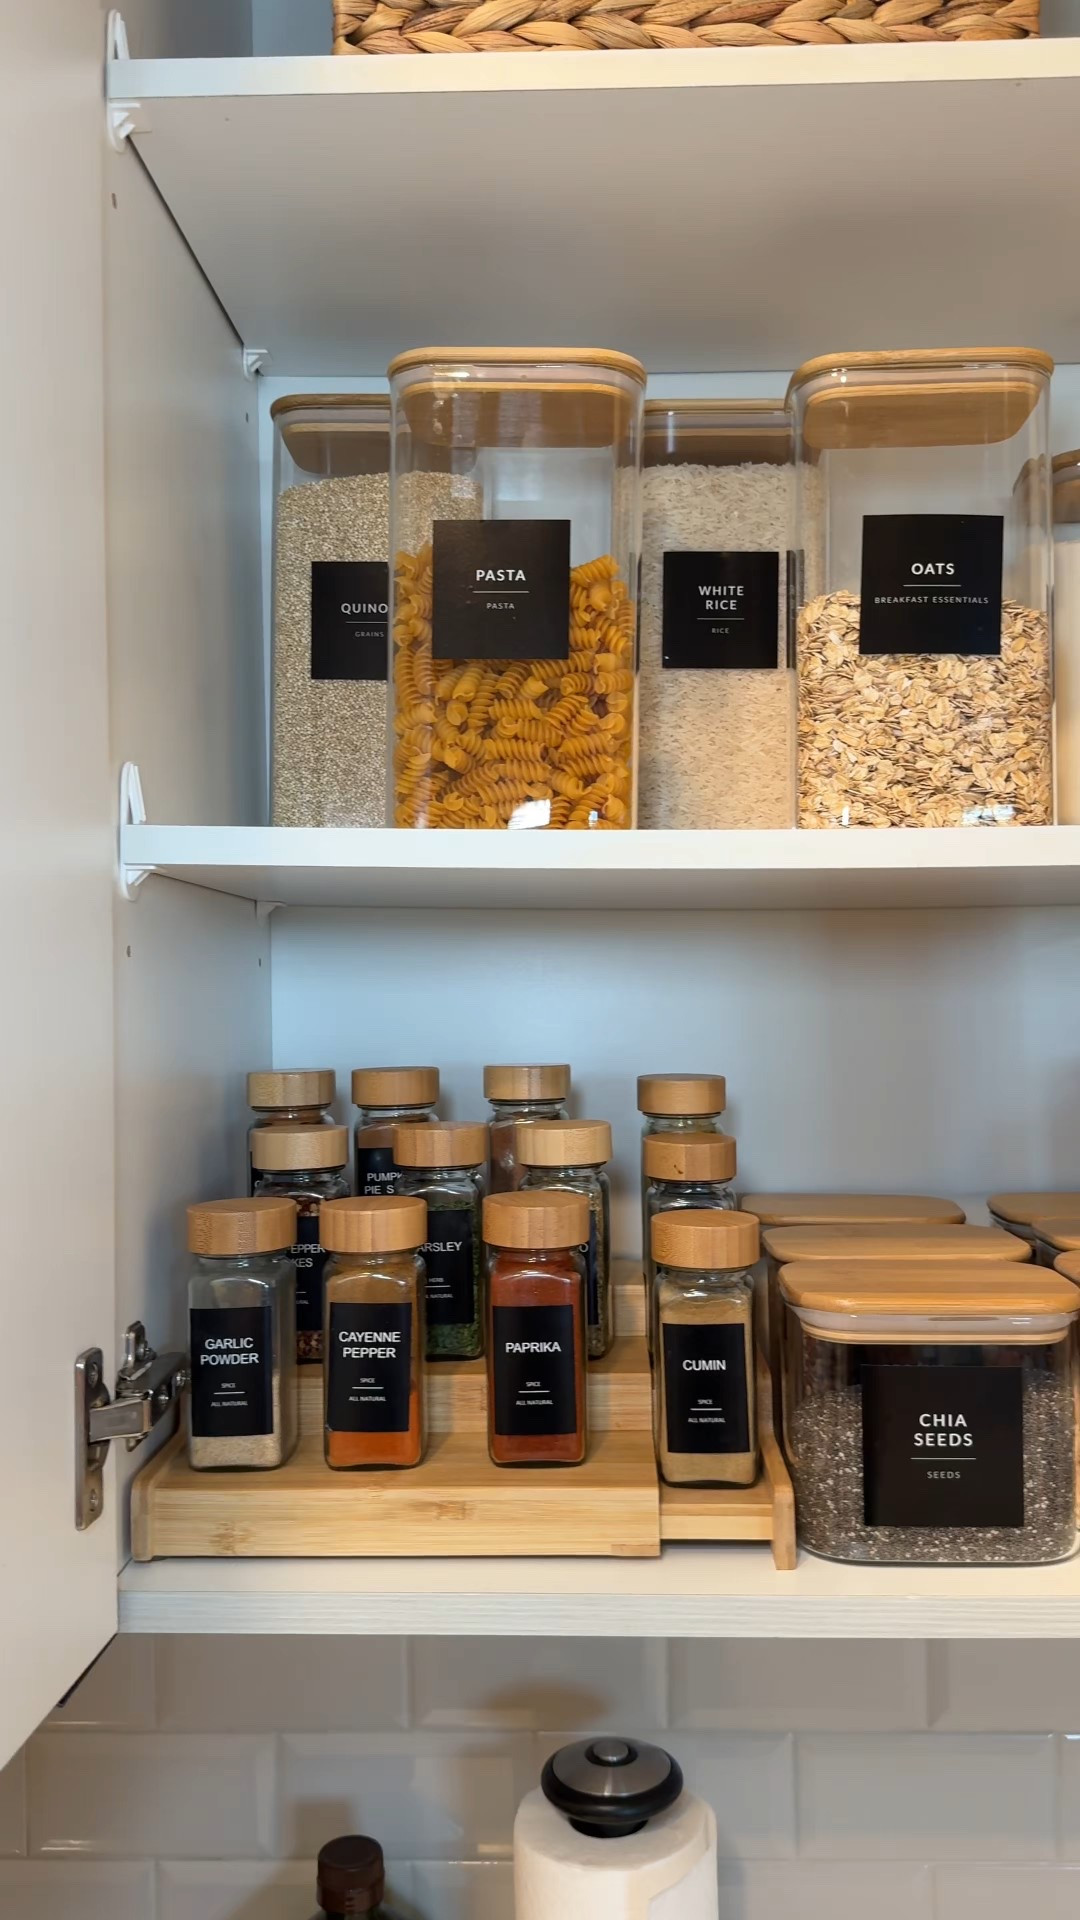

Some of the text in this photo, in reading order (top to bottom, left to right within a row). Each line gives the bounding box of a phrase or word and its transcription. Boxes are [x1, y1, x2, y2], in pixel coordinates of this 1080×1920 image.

[911, 562, 955, 575] OATS
[476, 569, 526, 582] PASTA
[698, 585, 744, 596] WHITE
[486, 602, 515, 610] PASTA
[705, 599, 737, 611] RICE
[874, 596, 989, 604] BREAKFAST ESSENTIALS
[340, 602, 388, 615] QUINO
[364, 1184, 382, 1195] PIE
[290, 1243, 326, 1254] EPPER
[416, 1241, 463, 1252] ARSLEY
[338, 1331, 401, 1343] CAYENNE
[204, 1337, 254, 1350] GARLIC
[505, 1341, 562, 1353] PAPRIKA
[342, 1346, 397, 1359] PEPPER
[200, 1352, 260, 1366] POWDER
[682, 1359, 727, 1371] CUMIN
[918, 1413, 968, 1427] CHIA
[913, 1432, 973, 1447] SEEDS
[926, 1470, 961, 1479] SEEDS
